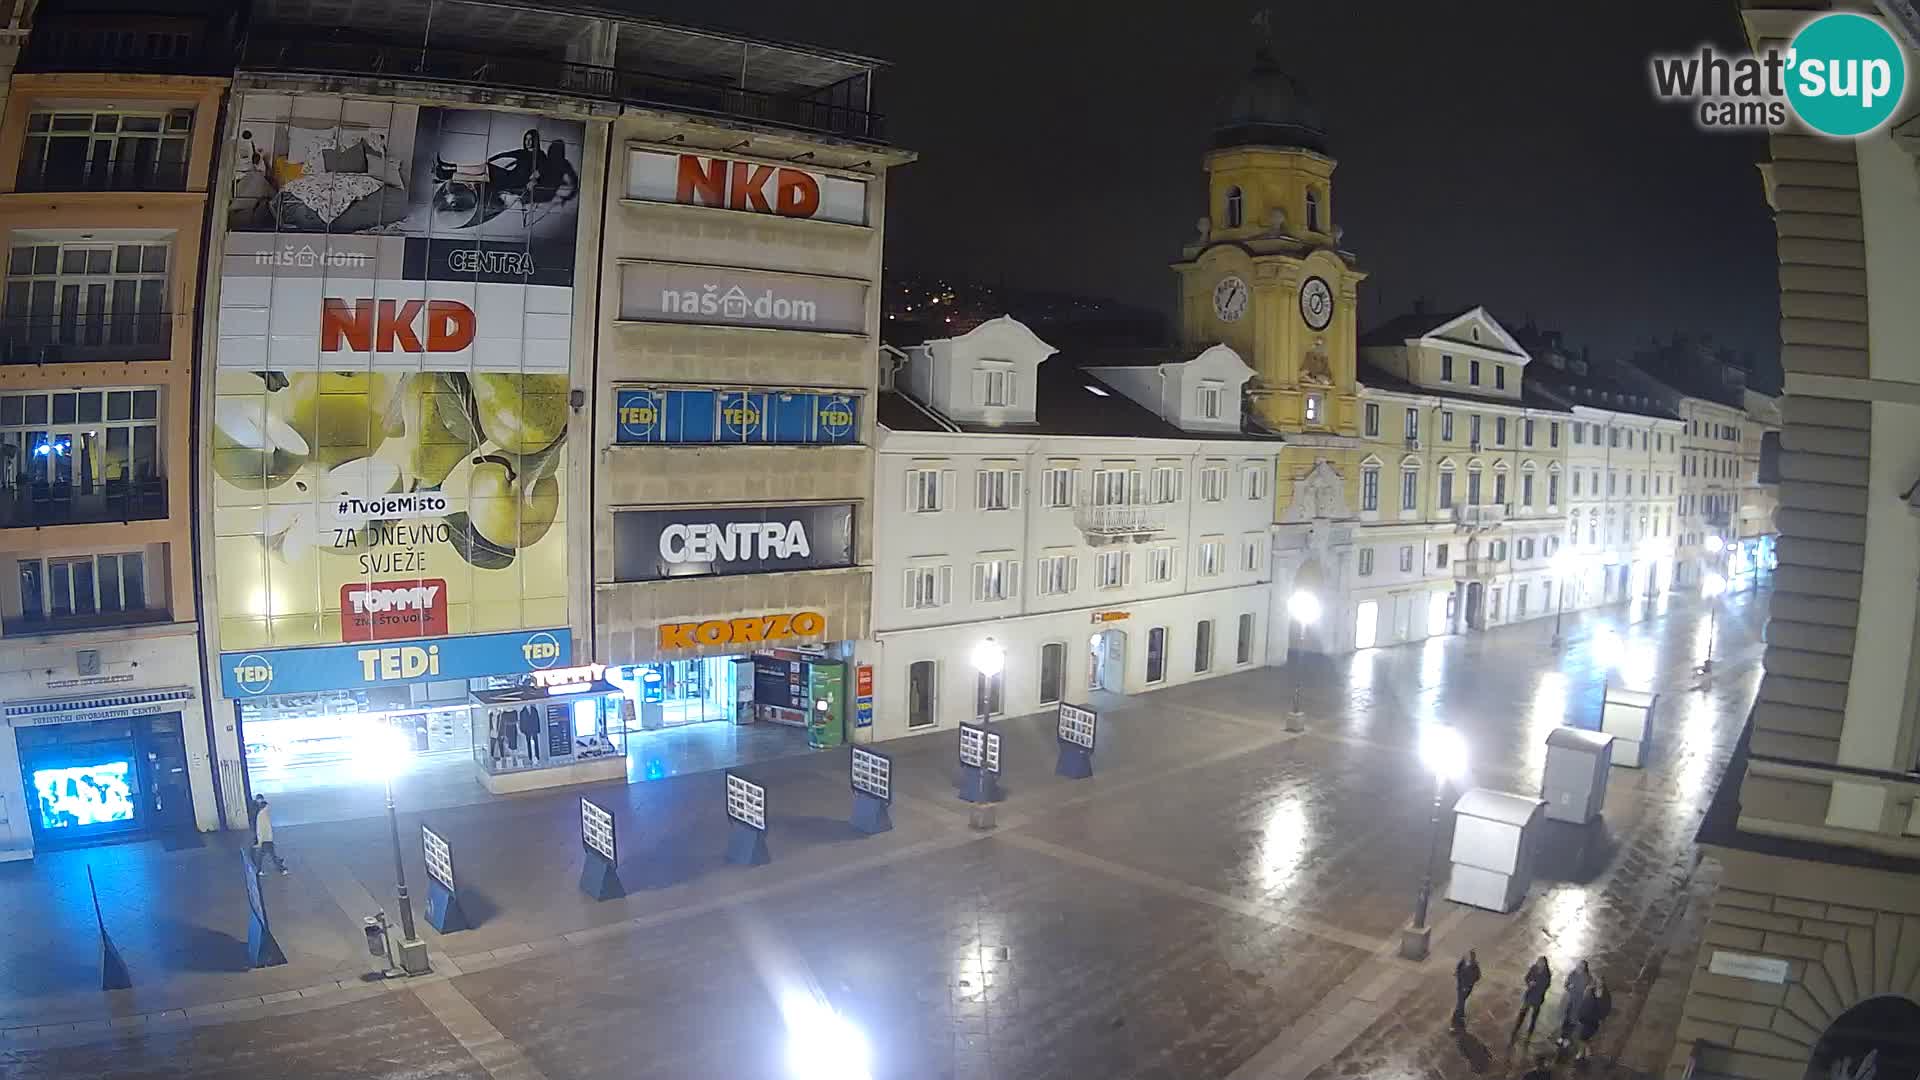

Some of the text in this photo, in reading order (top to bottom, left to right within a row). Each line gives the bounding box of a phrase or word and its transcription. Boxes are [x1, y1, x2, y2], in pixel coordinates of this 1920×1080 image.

[676, 153, 820, 219] NKD
[448, 249, 535, 276] CENTRA
[662, 284, 816, 322] naš dom
[321, 297, 477, 353] NKD
[619, 406, 658, 426] TEDi
[724, 408, 759, 426] TEDi
[820, 410, 853, 426] TEDi
[338, 496, 446, 516] #TvojeMisto
[333, 523, 450, 548] ZA DNEVNO
[659, 520, 810, 564] CENTRA
[359, 547, 427, 574] SVJEŽE
[348, 585, 439, 614] TOMMY
[658, 611, 825, 650] KORZO
[358, 645, 440, 681] TEDi
[522, 643, 560, 660] TEDi
[233, 665, 273, 683] TEDi
